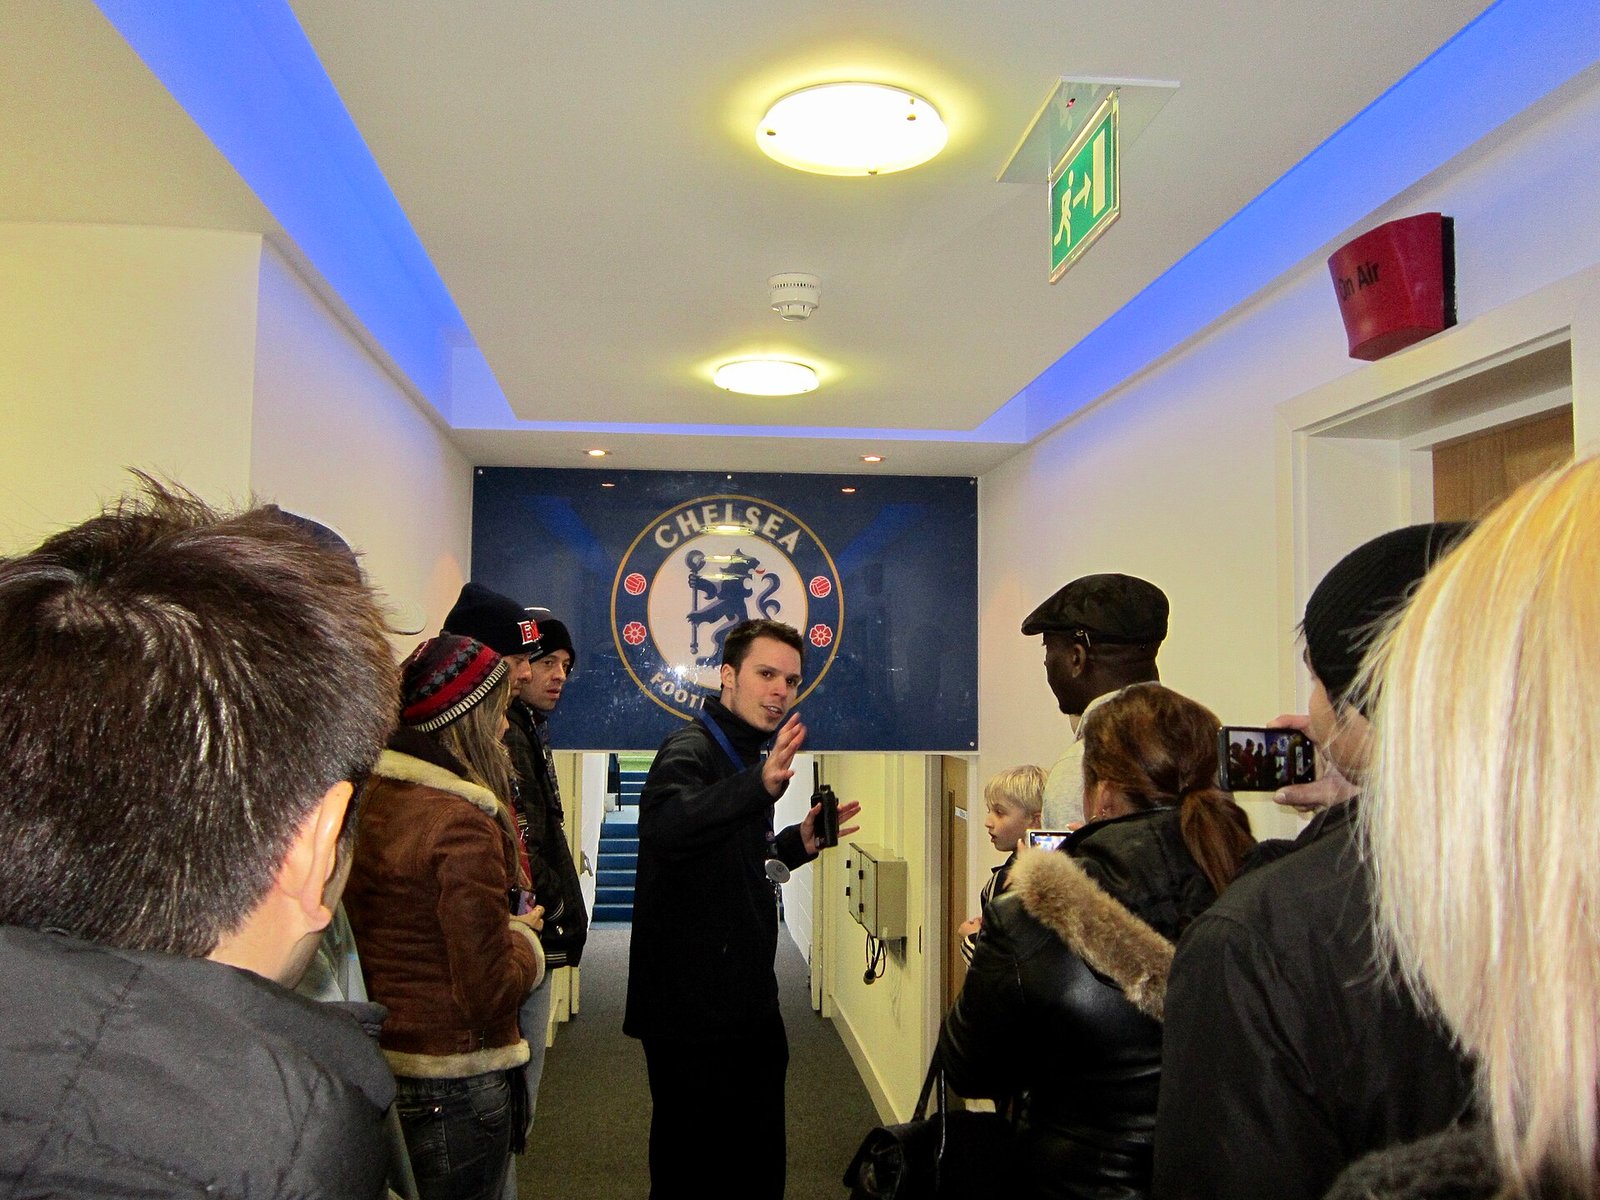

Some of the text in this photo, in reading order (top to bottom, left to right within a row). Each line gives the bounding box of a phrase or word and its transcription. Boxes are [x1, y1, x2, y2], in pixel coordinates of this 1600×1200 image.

[1338, 261, 1380, 301] On Air
[654, 502, 801, 554] CHELSEA
[650, 671, 706, 710] FOOT
